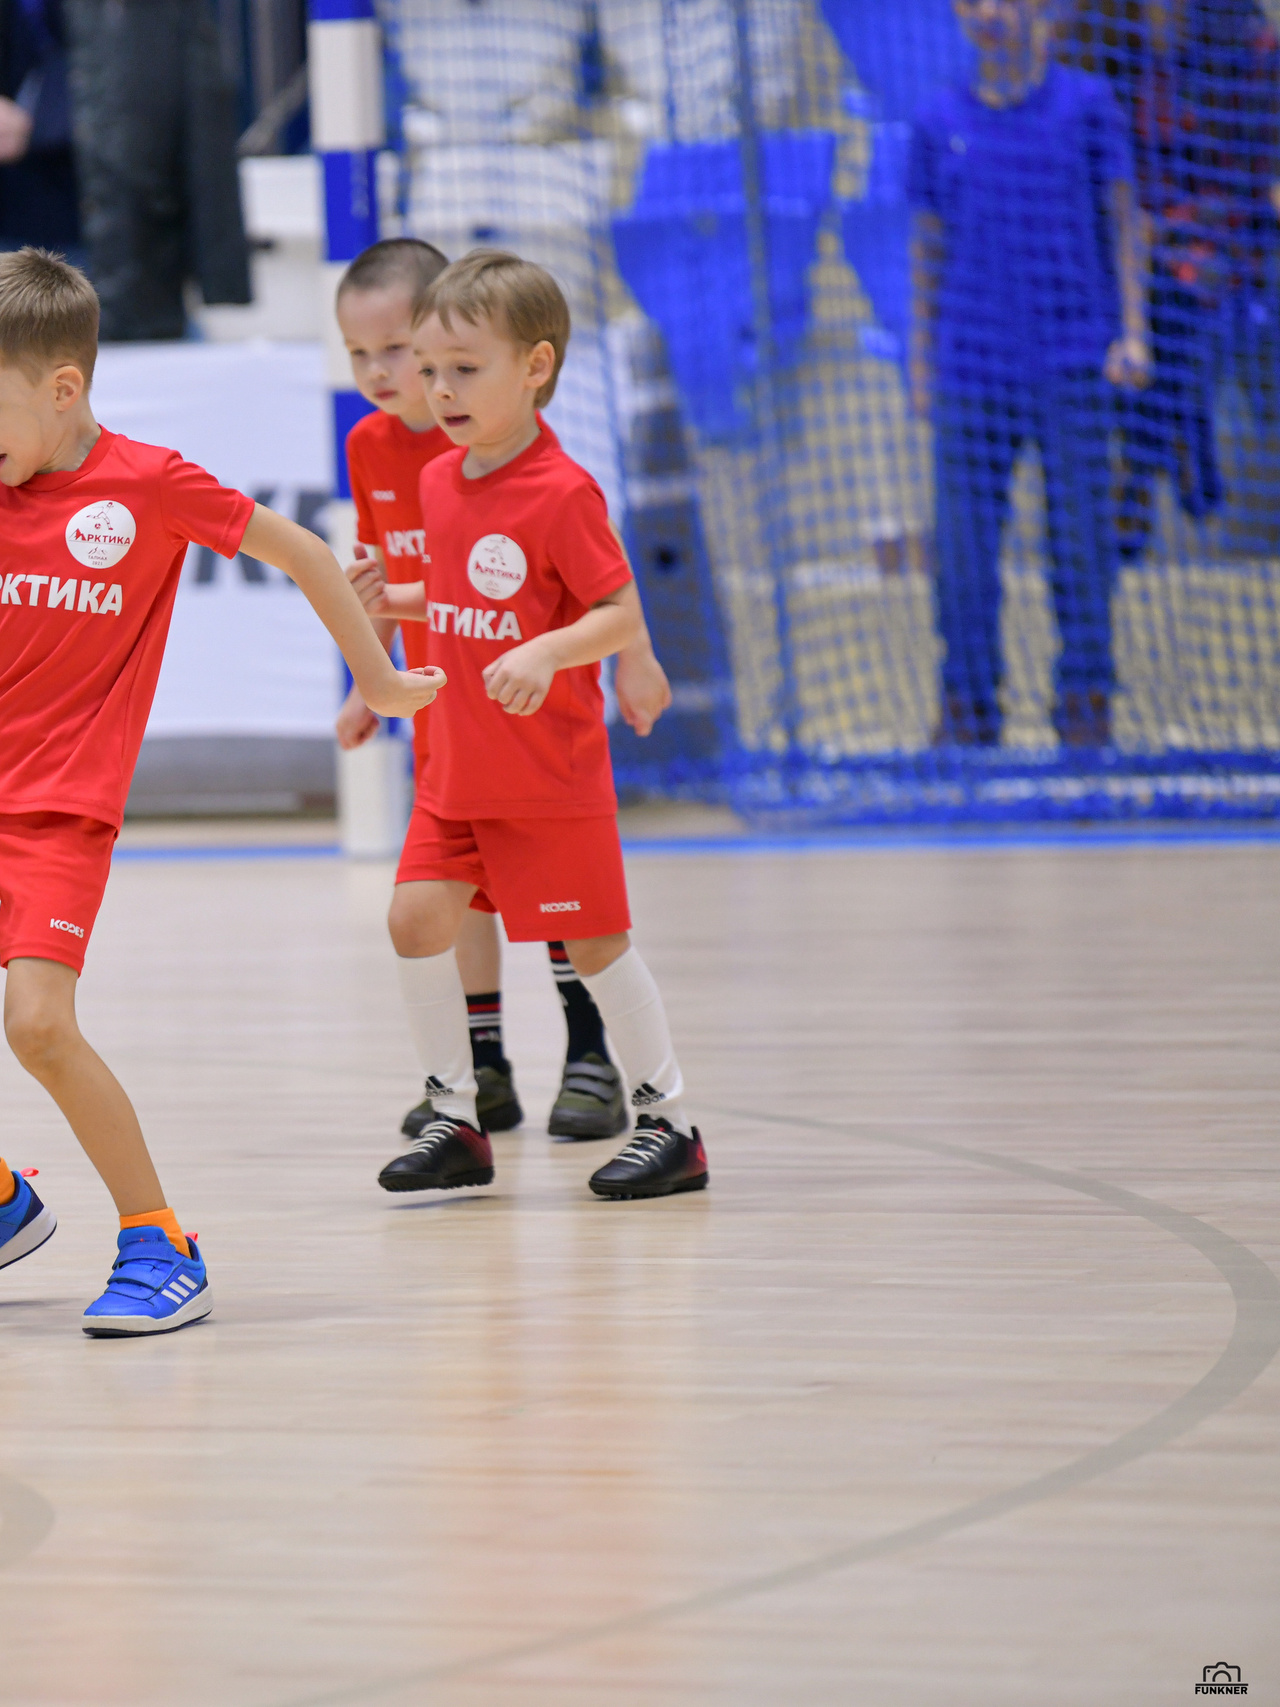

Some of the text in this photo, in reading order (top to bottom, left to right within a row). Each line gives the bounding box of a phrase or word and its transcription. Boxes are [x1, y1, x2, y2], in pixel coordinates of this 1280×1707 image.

[74, 528, 131, 545] АРКТИКА
[540, 901, 582, 913] KODES
[50, 918, 85, 939] KODES
